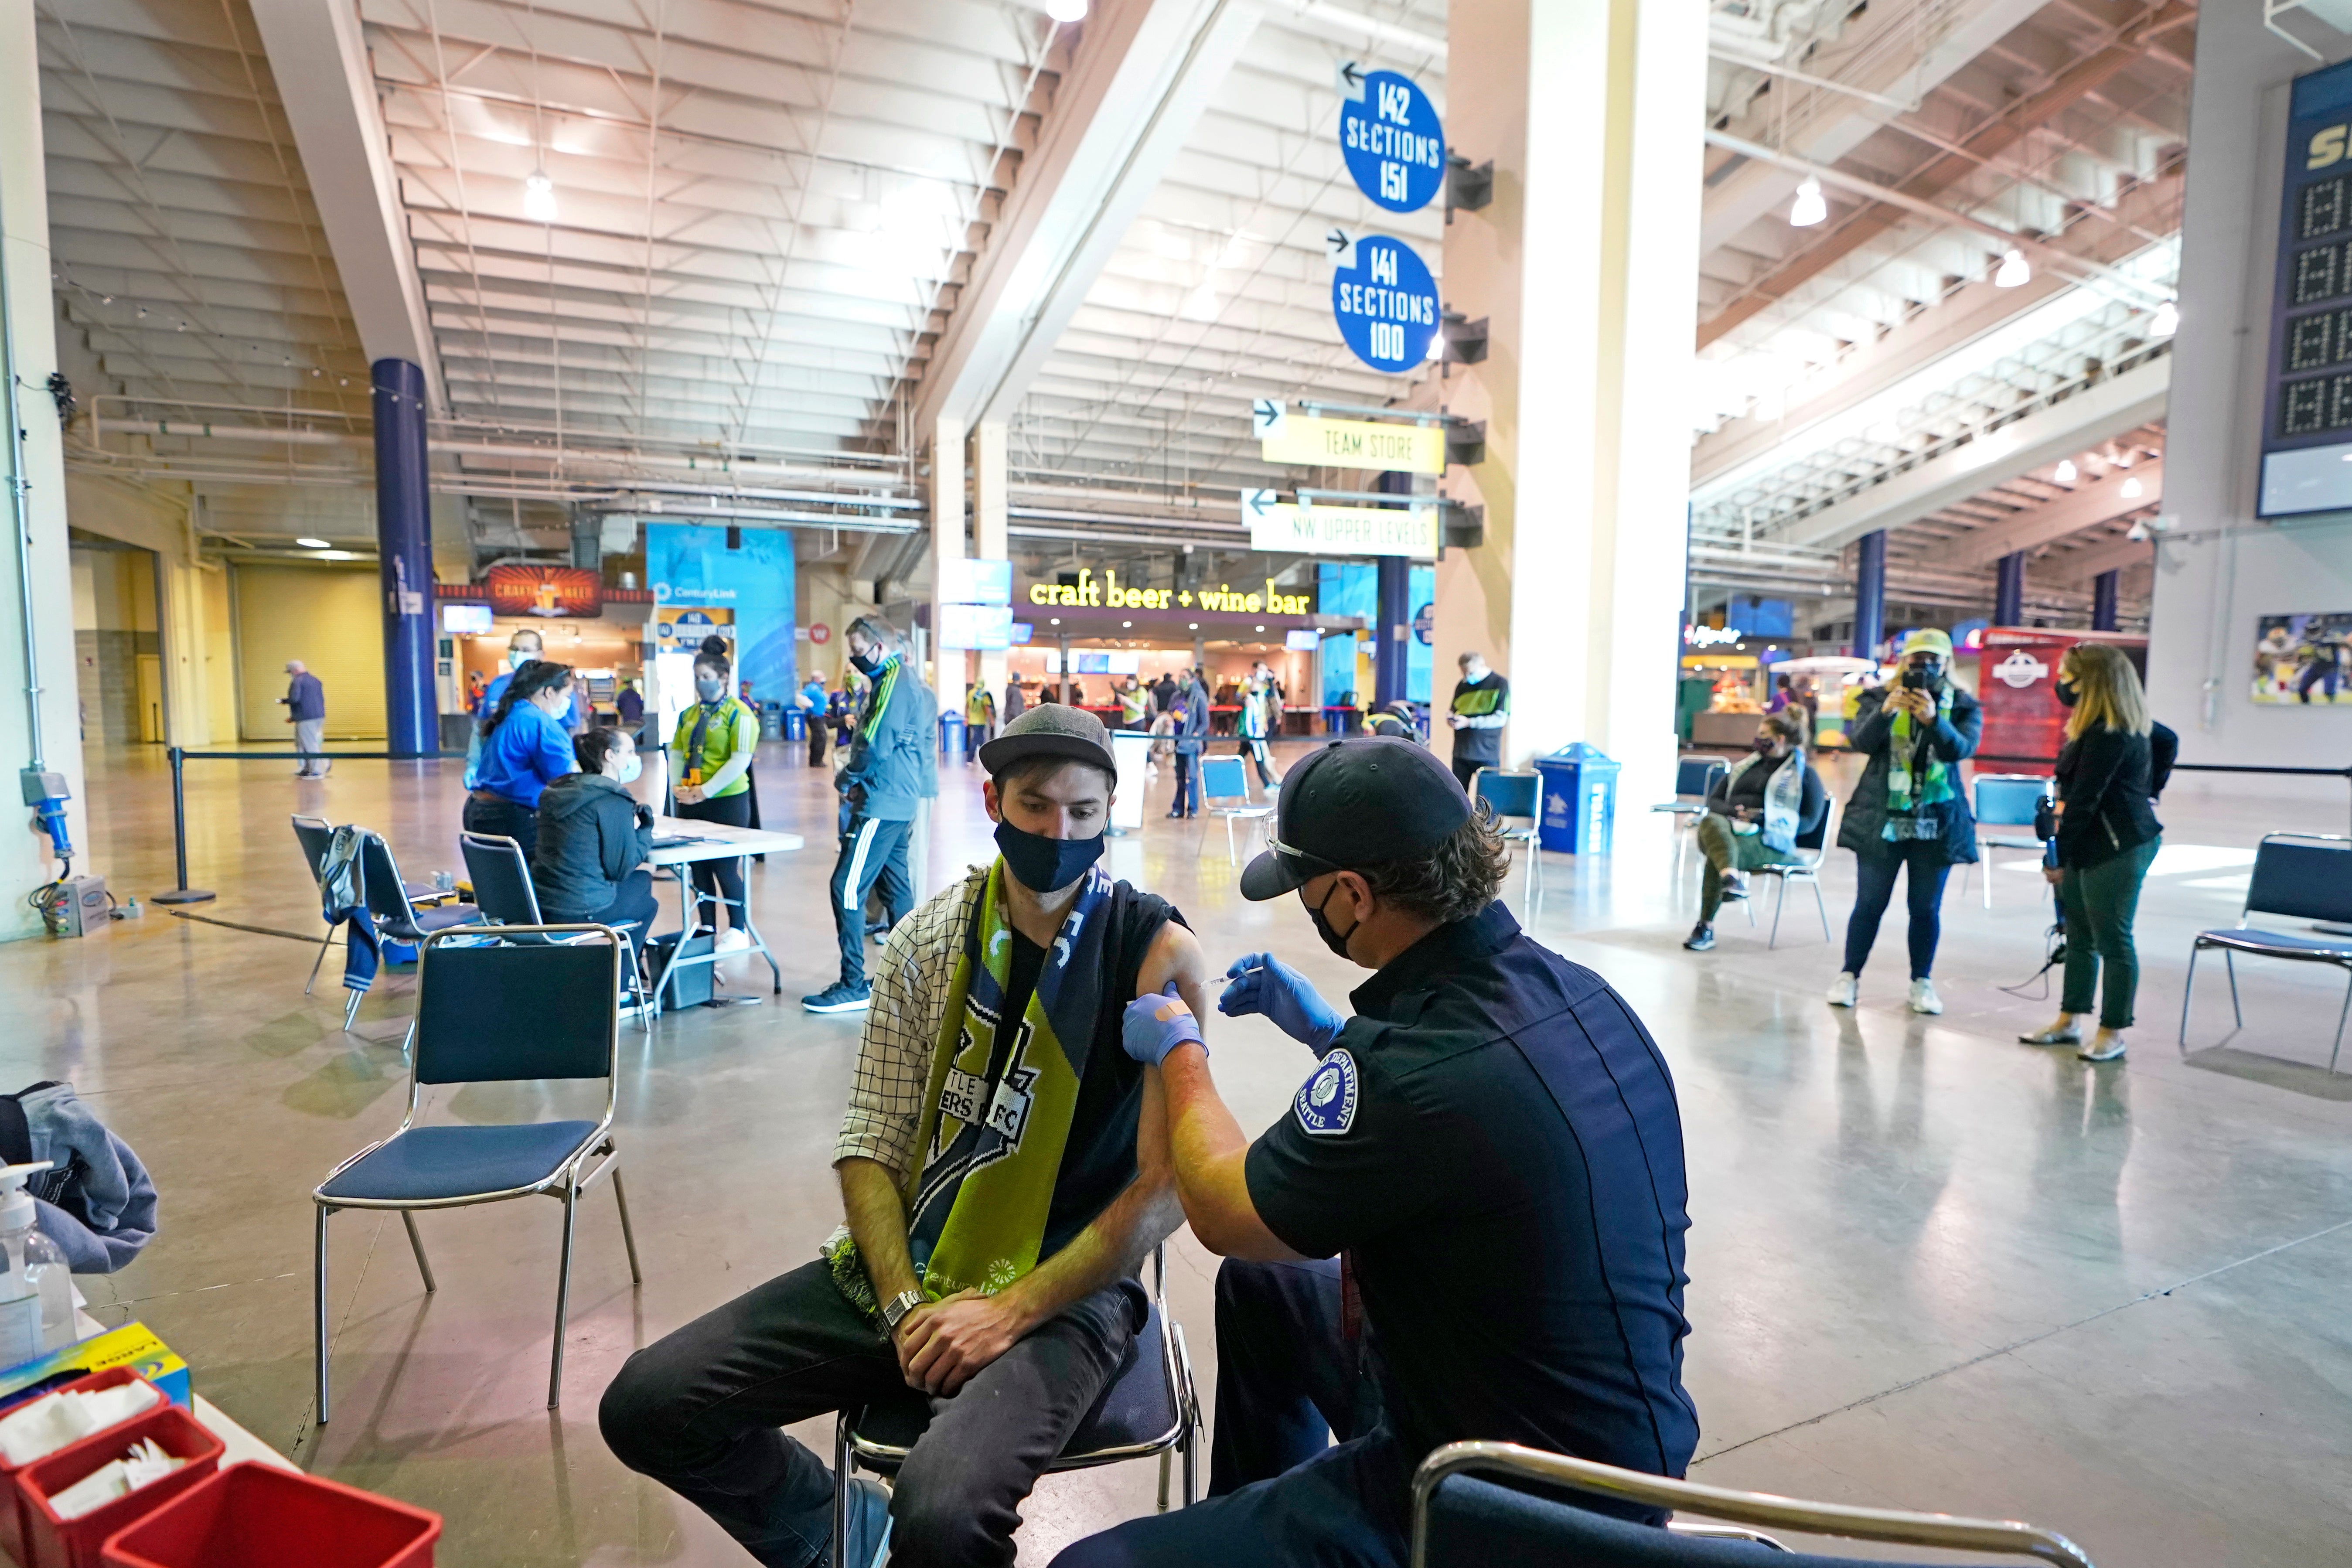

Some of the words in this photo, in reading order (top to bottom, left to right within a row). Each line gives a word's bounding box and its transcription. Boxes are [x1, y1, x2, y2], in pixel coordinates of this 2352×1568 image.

[1378, 81, 1411, 127] 142
[1347, 116, 1439, 169] SECTIONS
[1380, 161, 1408, 203] 151
[1370, 246, 1397, 287] 141
[1340, 283, 1434, 326] SECTIONS
[1370, 322, 1404, 362] 100
[1325, 430, 1362, 456] TEAM
[1370, 434, 1412, 461] STORE
[1293, 517, 1316, 539] NW
[1324, 518, 1371, 543] UPPER
[1379, 522, 1427, 546] LEVELS
[675, 587, 736, 599] CenturyLink
[1029, 568, 1100, 607] craft
[1106, 569, 1172, 609] beer
[1199, 584, 1261, 613] wine
[1266, 578, 1309, 615] bar
[1299, 1088, 1326, 1128] SEATTLE
[1330, 1052, 1354, 1127] DEPARTMENT
[993, 1104, 1018, 1131] FC
